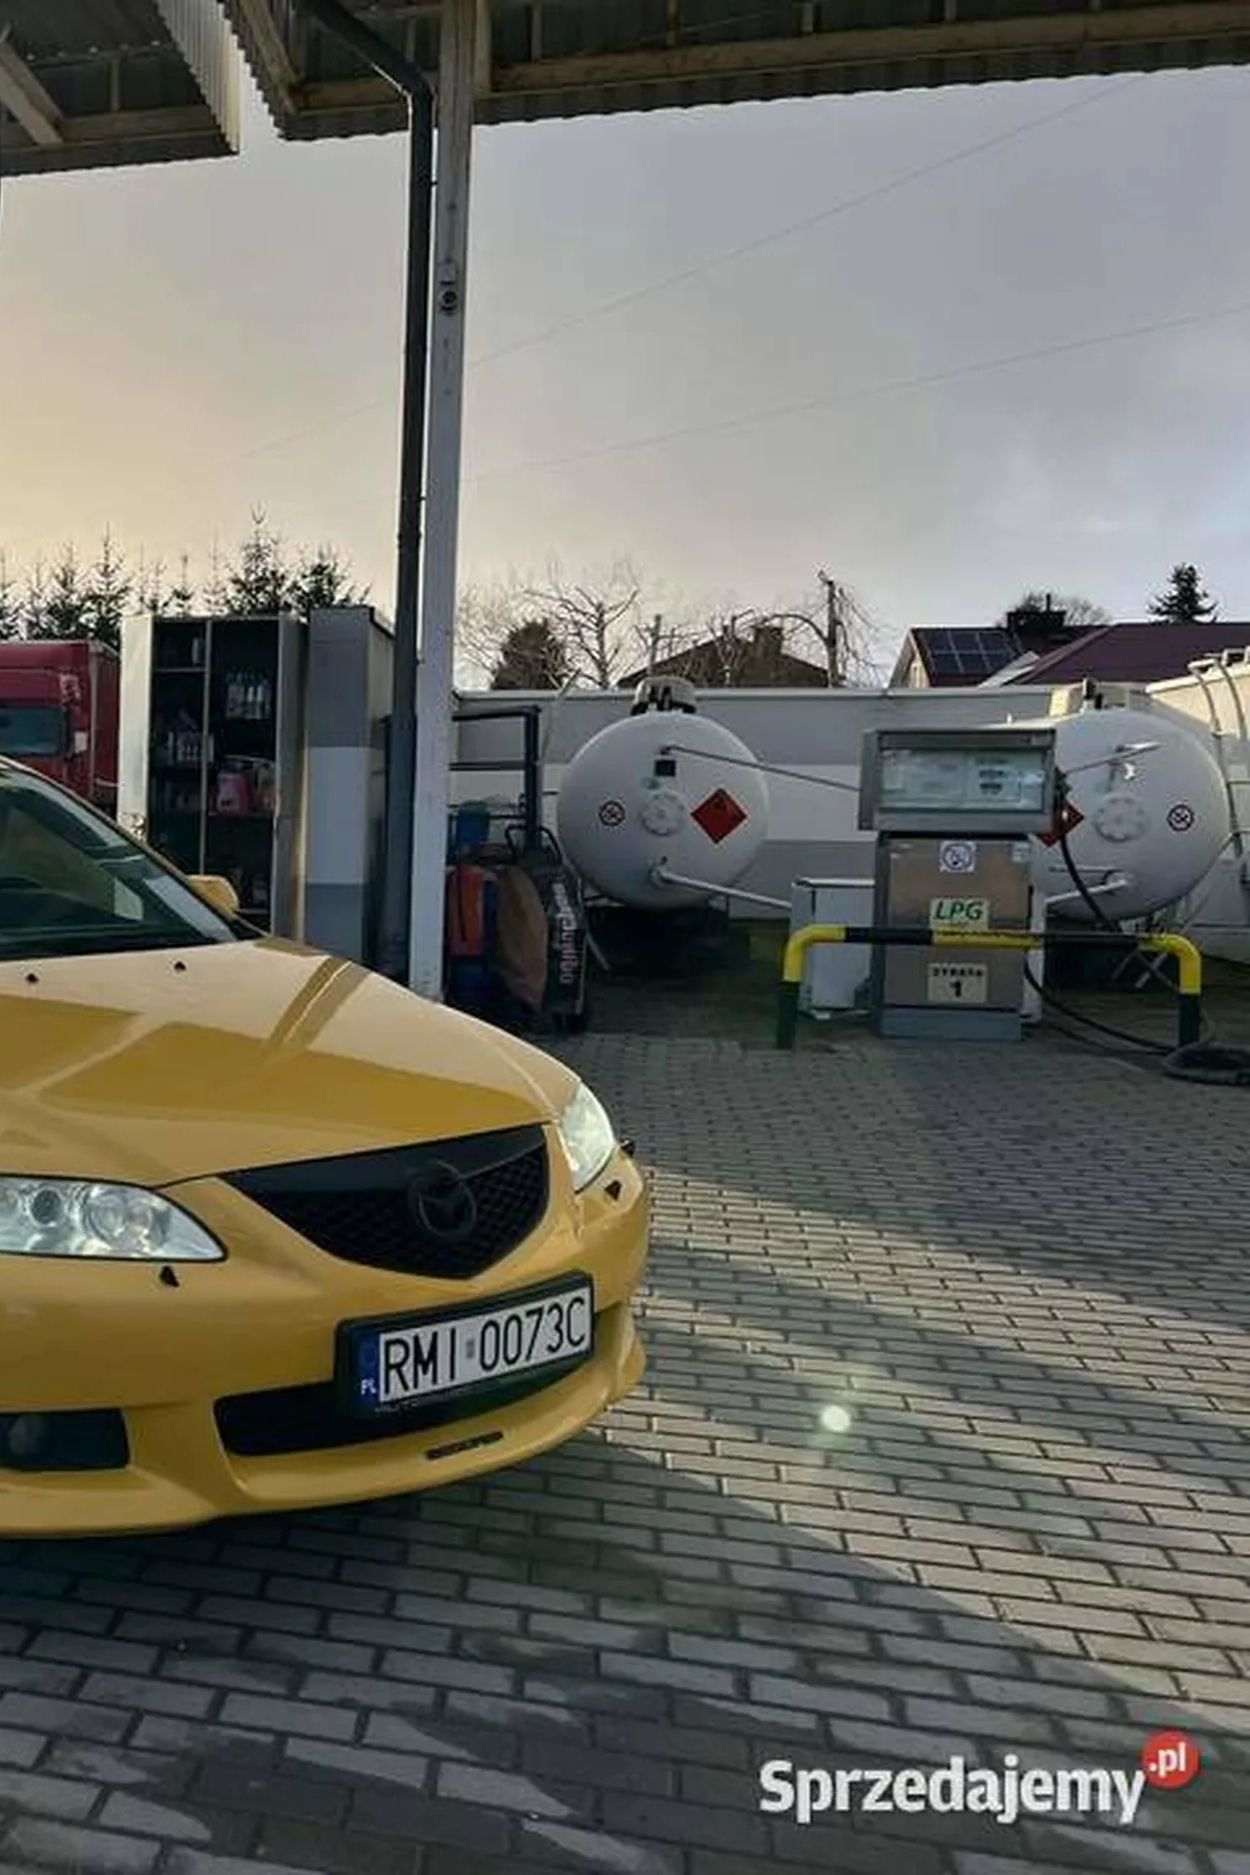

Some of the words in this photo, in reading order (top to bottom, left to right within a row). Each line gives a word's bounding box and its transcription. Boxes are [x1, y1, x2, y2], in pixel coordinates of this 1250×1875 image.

[935, 900, 984, 920] LPG
[383, 1327, 458, 1394] RMI
[479, 1296, 586, 1372] 0073C
[360, 1379, 378, 1395] PL
